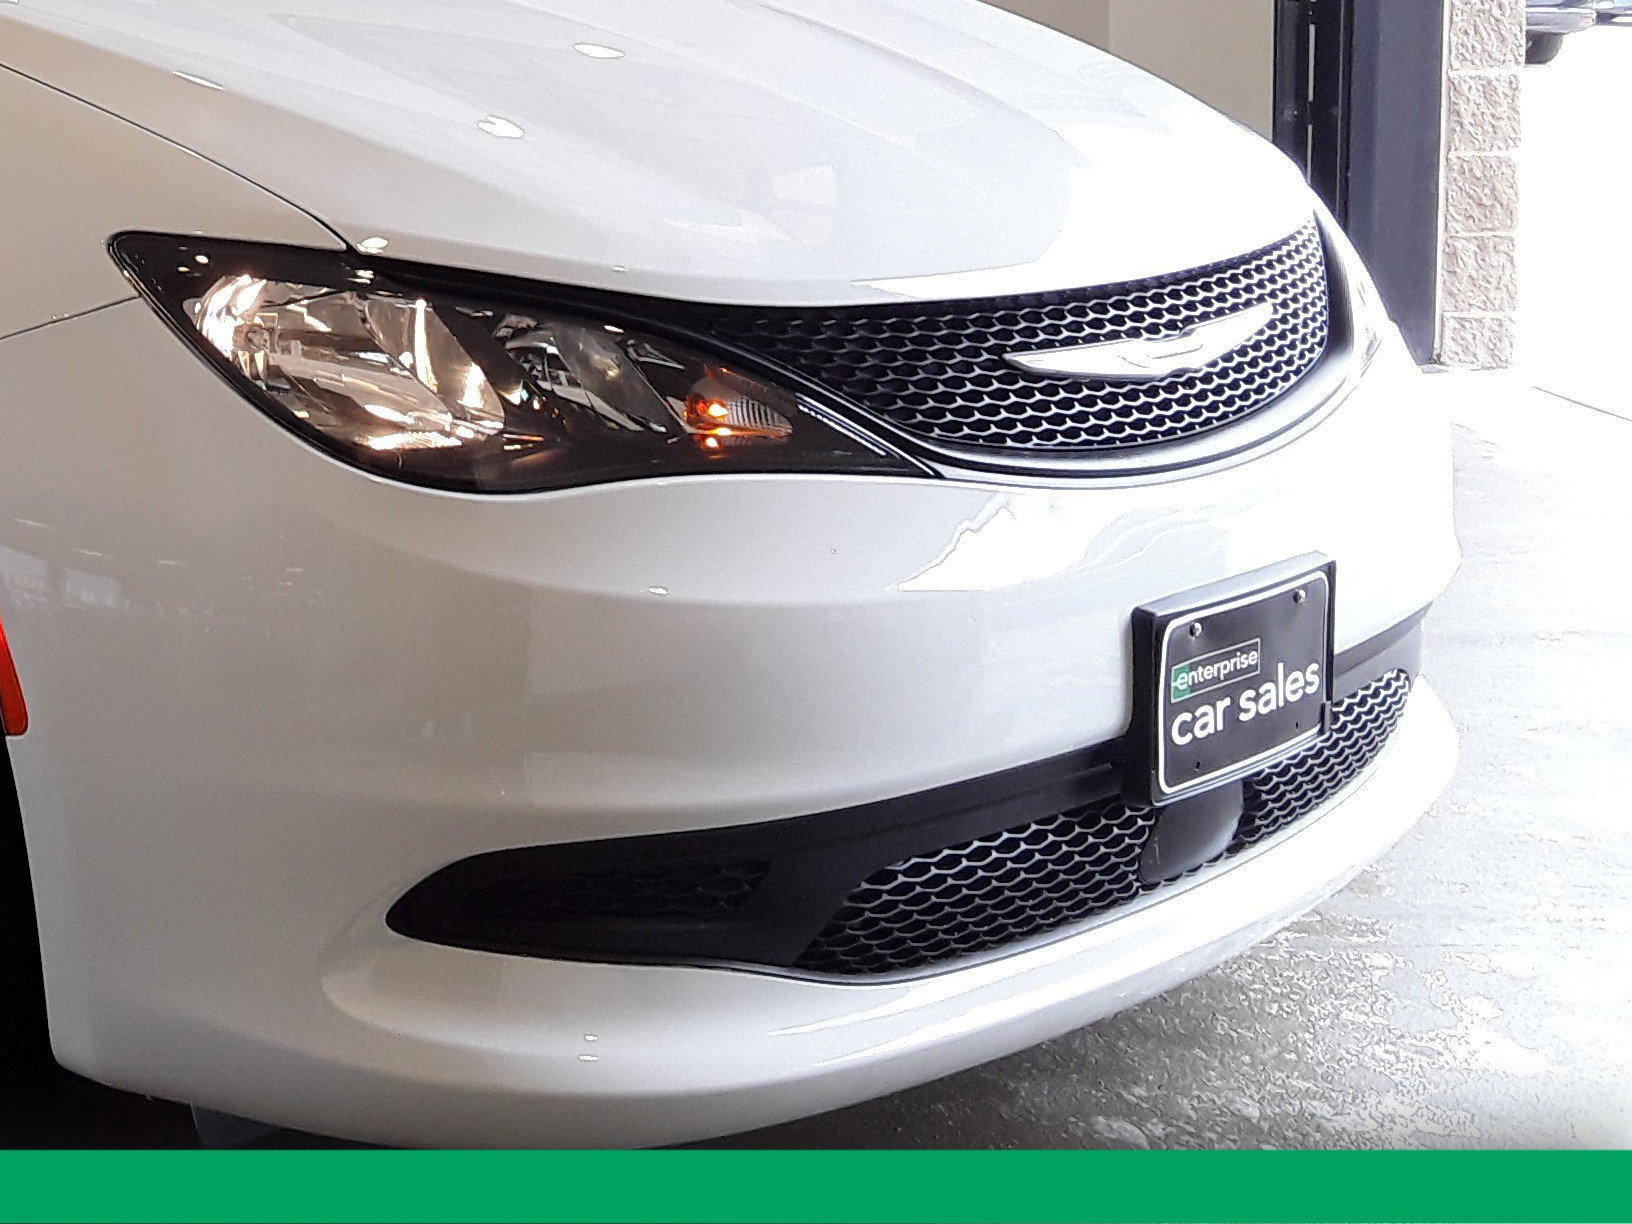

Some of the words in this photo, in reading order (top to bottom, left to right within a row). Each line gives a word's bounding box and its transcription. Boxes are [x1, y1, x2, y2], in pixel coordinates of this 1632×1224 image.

[1175, 650, 1259, 690] enterprise
[1171, 696, 1231, 745] car
[1238, 662, 1320, 721] sales
